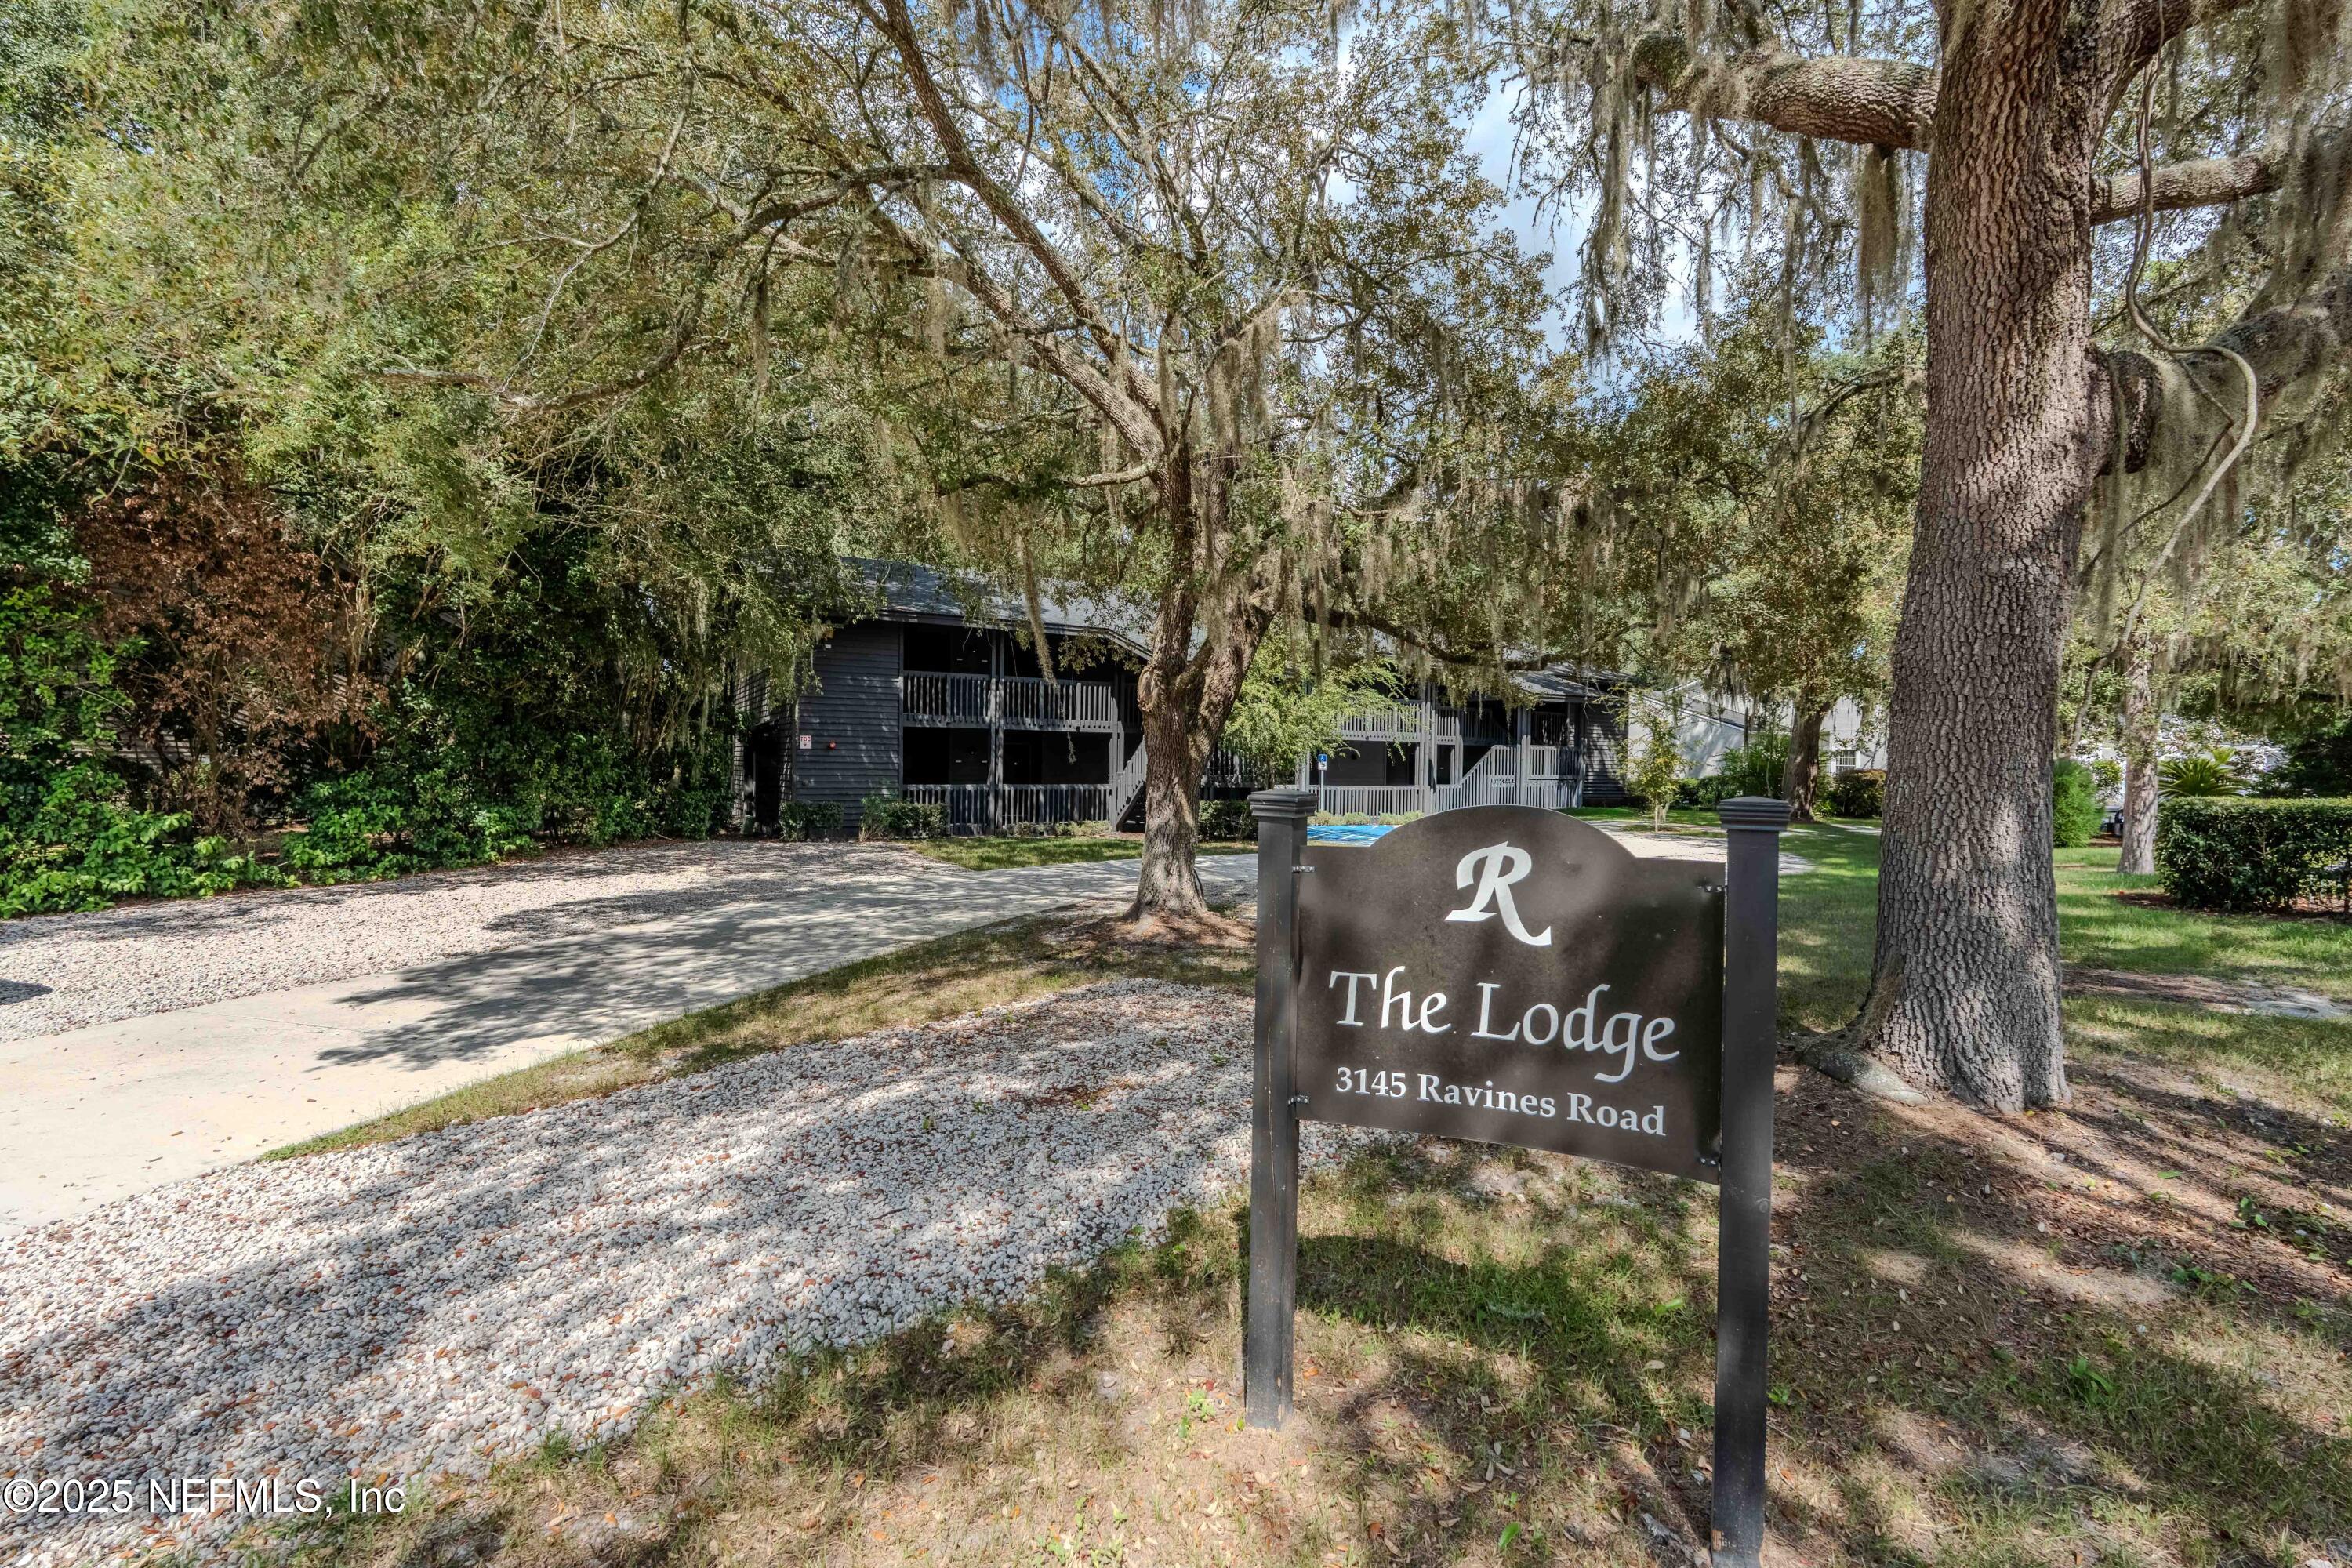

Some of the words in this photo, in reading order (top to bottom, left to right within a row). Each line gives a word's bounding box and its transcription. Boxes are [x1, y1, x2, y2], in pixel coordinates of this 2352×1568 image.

[1444, 840, 1552, 946] R
[1329, 965, 1452, 1034] The
[1469, 982, 1680, 1083] Lodge
[1335, 1066, 1407, 1099] 3145
[1417, 1073, 1556, 1118] Ravines
[1566, 1092, 1667, 1137] Road
